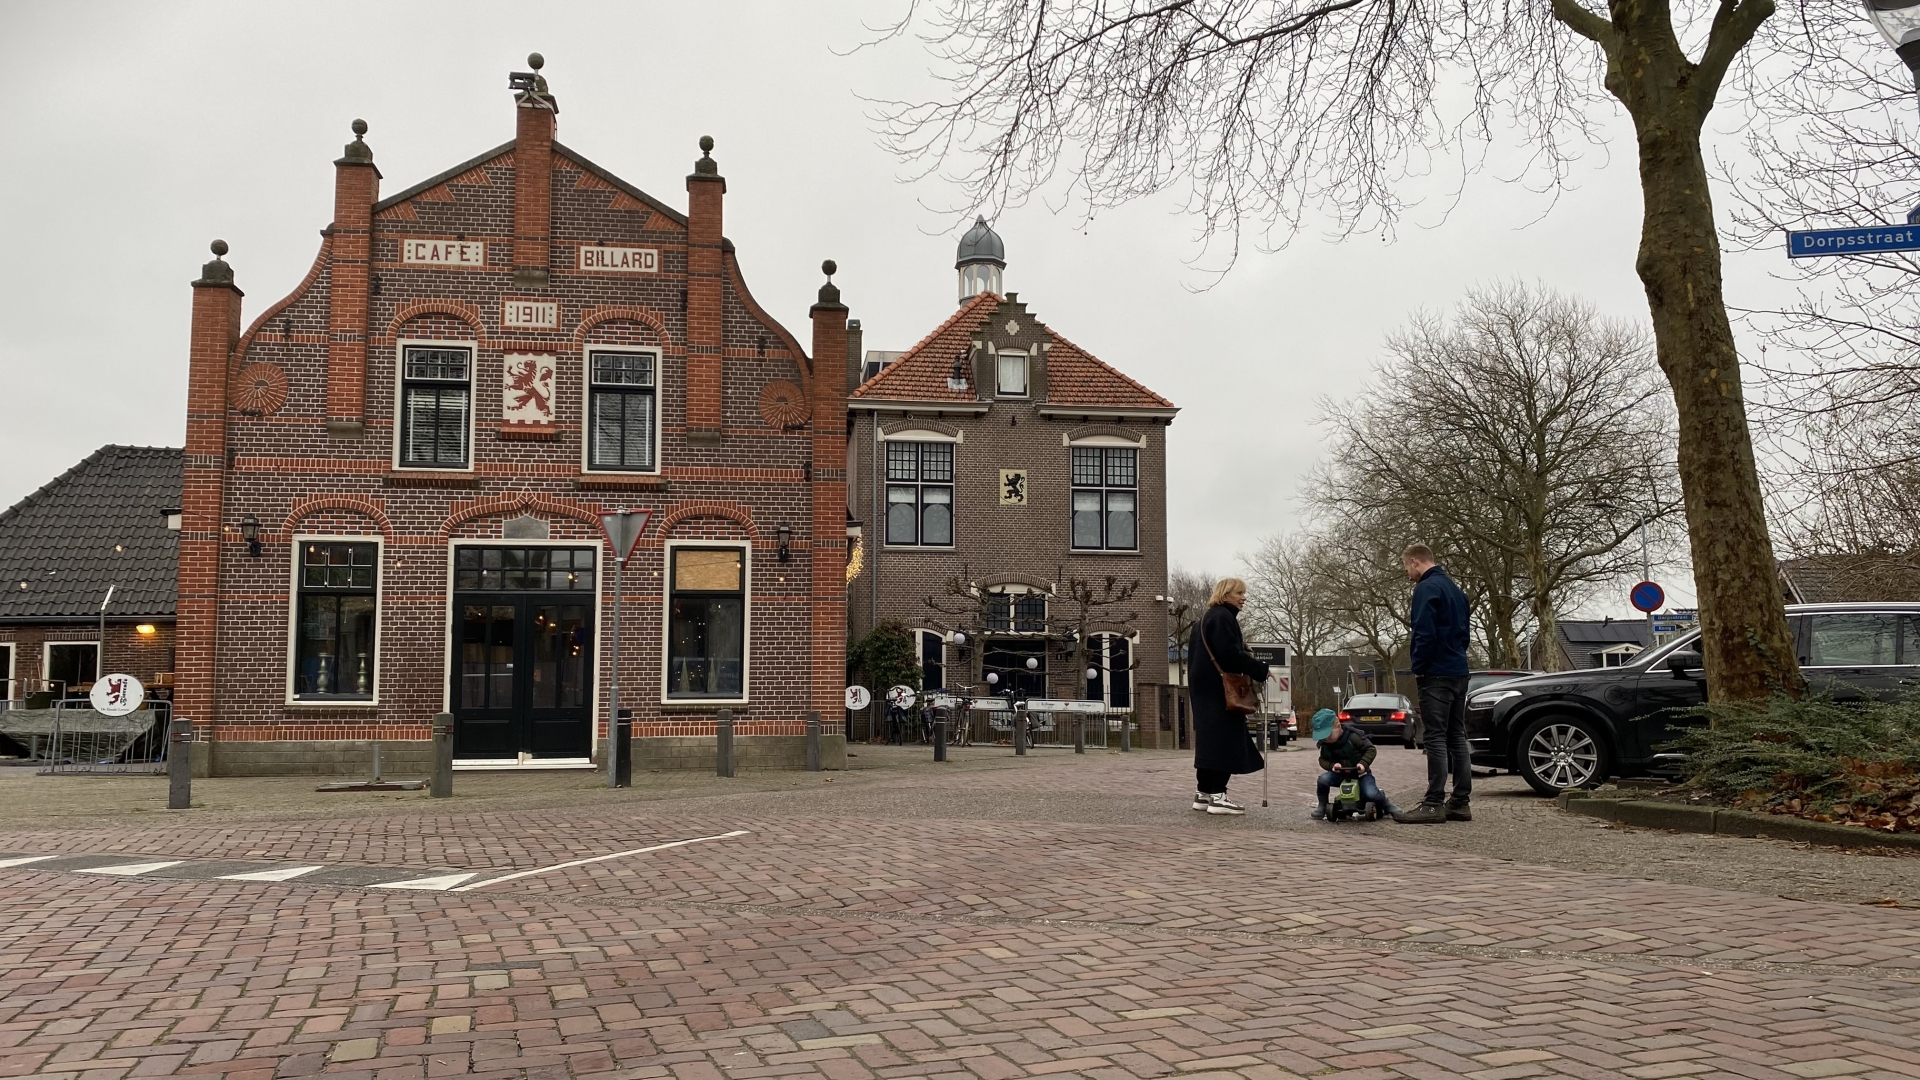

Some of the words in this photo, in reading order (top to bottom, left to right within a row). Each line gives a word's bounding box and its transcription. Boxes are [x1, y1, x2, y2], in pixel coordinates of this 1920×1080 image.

[1803, 230, 1914, 248] Dorpsstraat
[415, 242, 471, 262] CAFE
[584, 250, 654, 269] BILLARD
[516, 305, 546, 323] 1911
